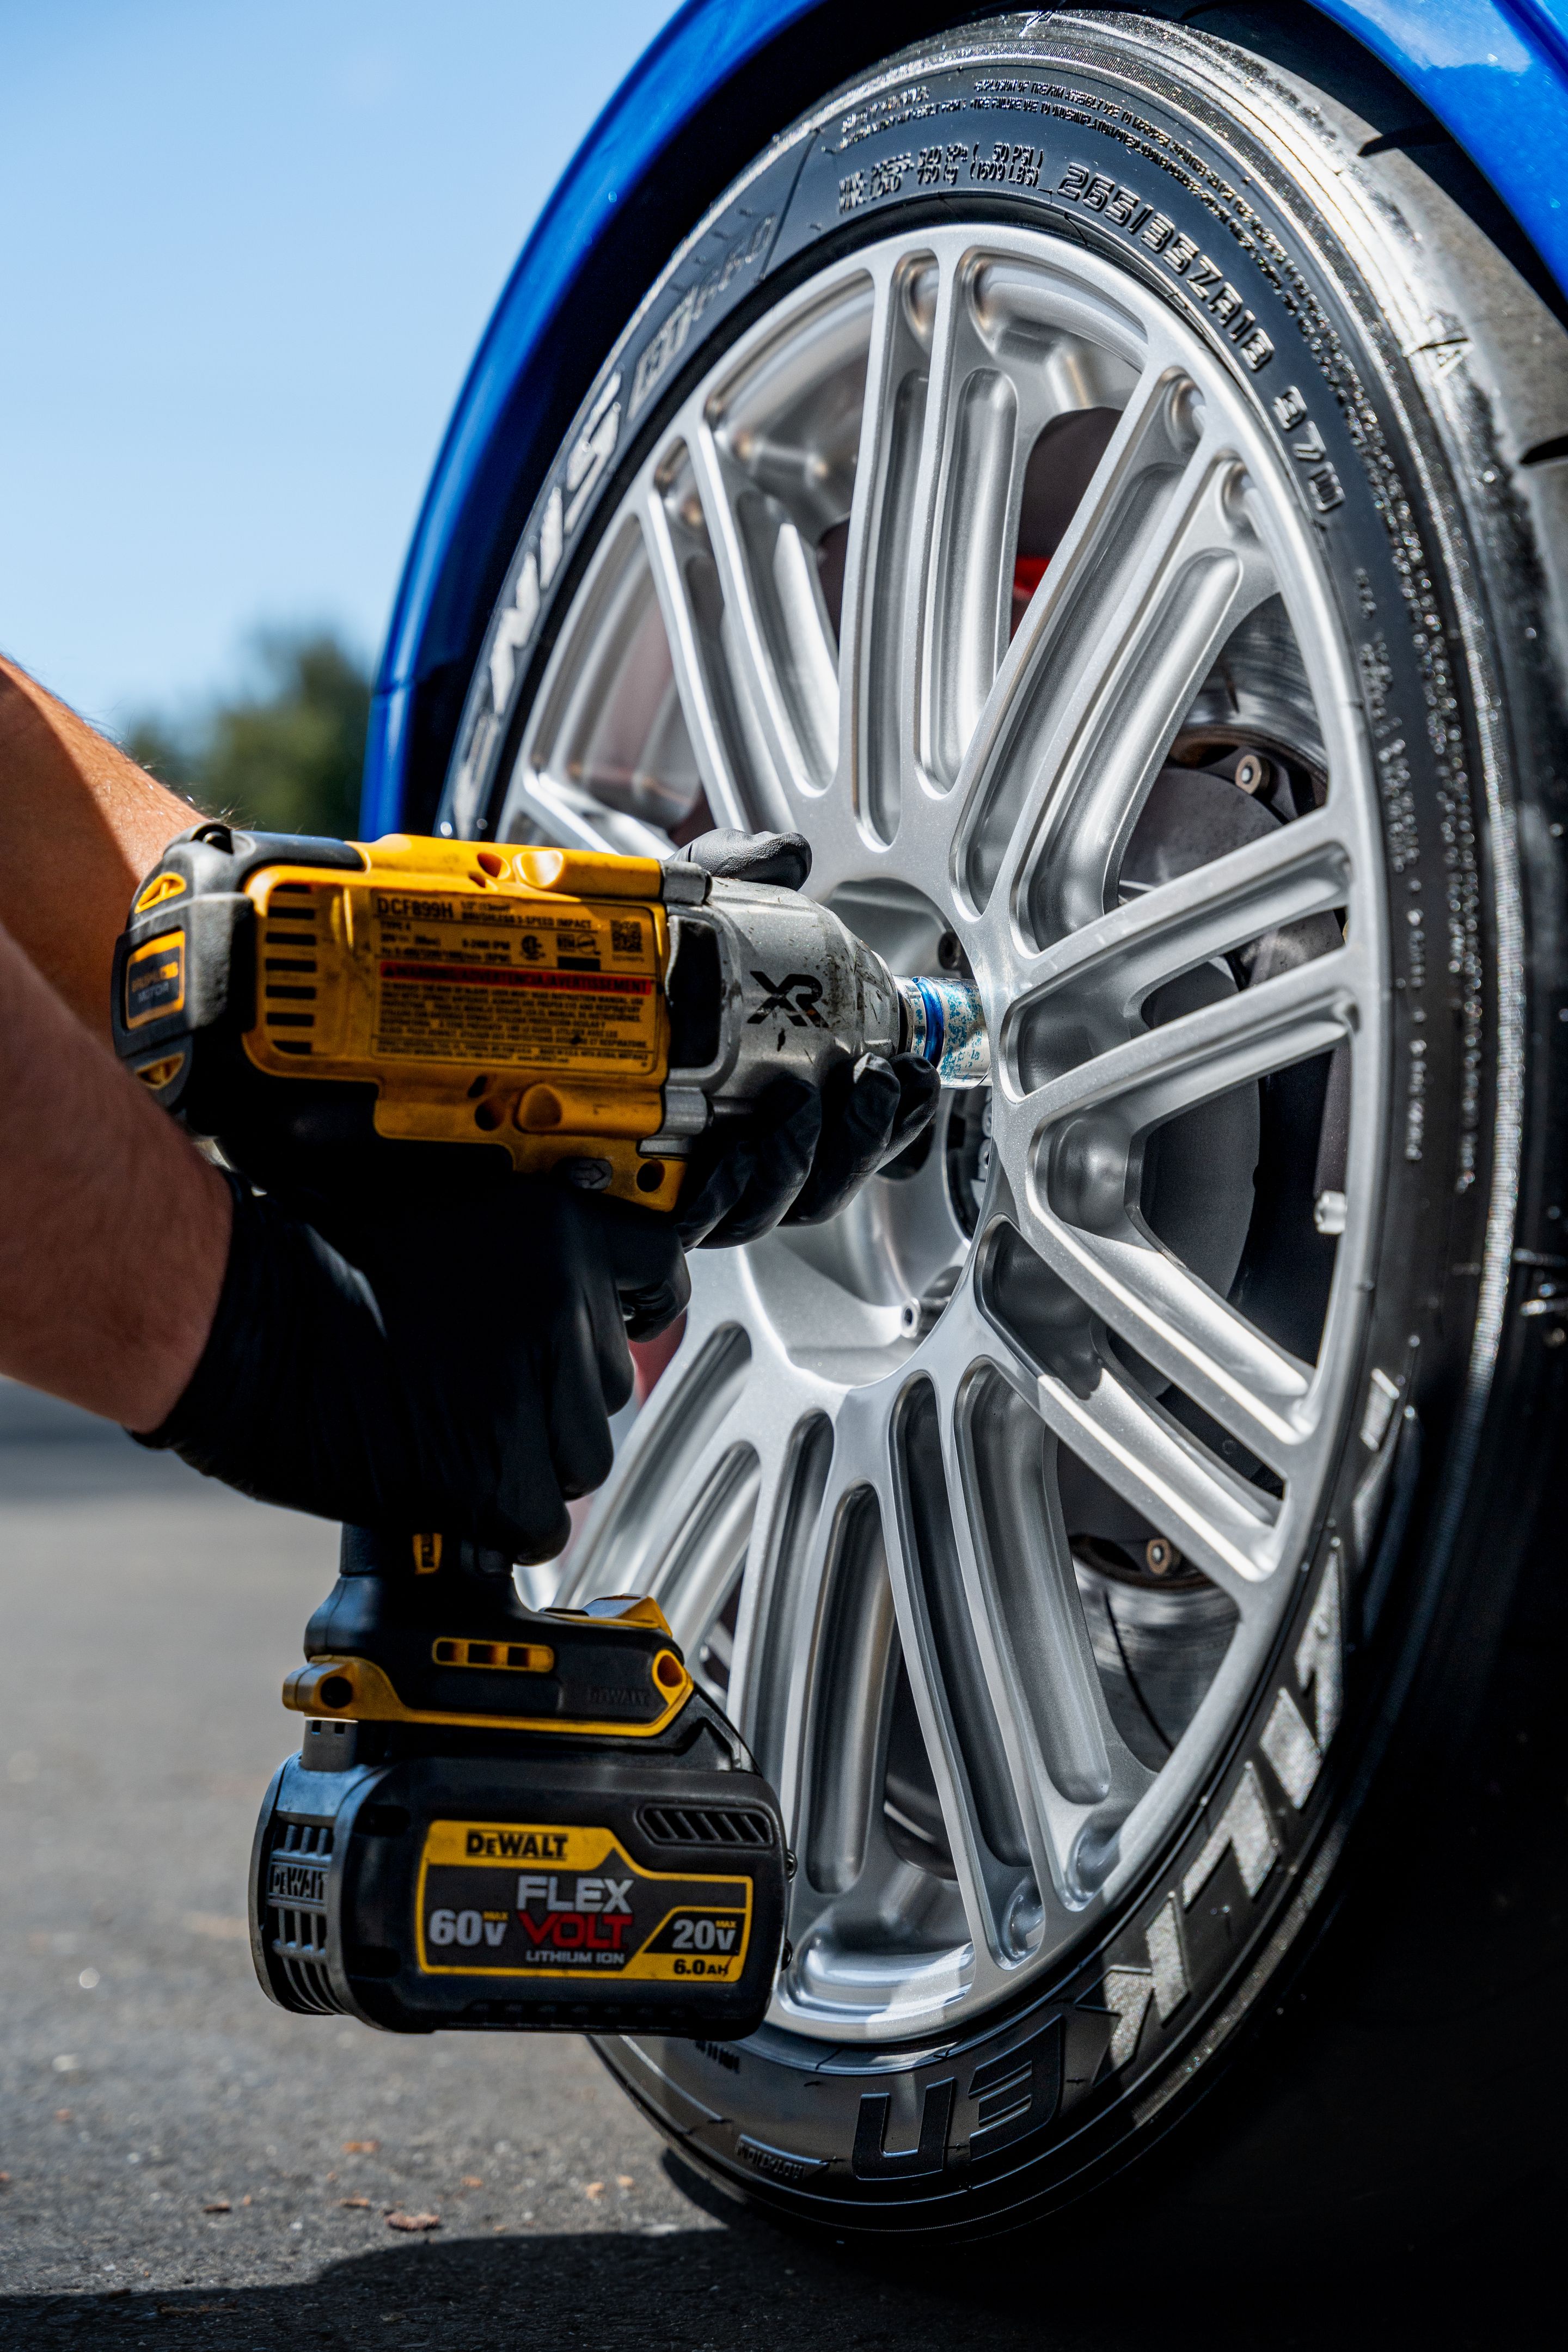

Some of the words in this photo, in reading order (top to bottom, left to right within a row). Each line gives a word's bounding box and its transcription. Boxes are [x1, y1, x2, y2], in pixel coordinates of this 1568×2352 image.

[746, 971, 830, 1028] XR
[517, 1875, 634, 1914] FLEX
[428, 1908, 507, 1947] 60V
[517, 1911, 633, 1949] VOLT
[671, 1919, 737, 1951] 20V
[525, 1949, 592, 1964] LITHIUM
[596, 1951, 625, 1964] ION
